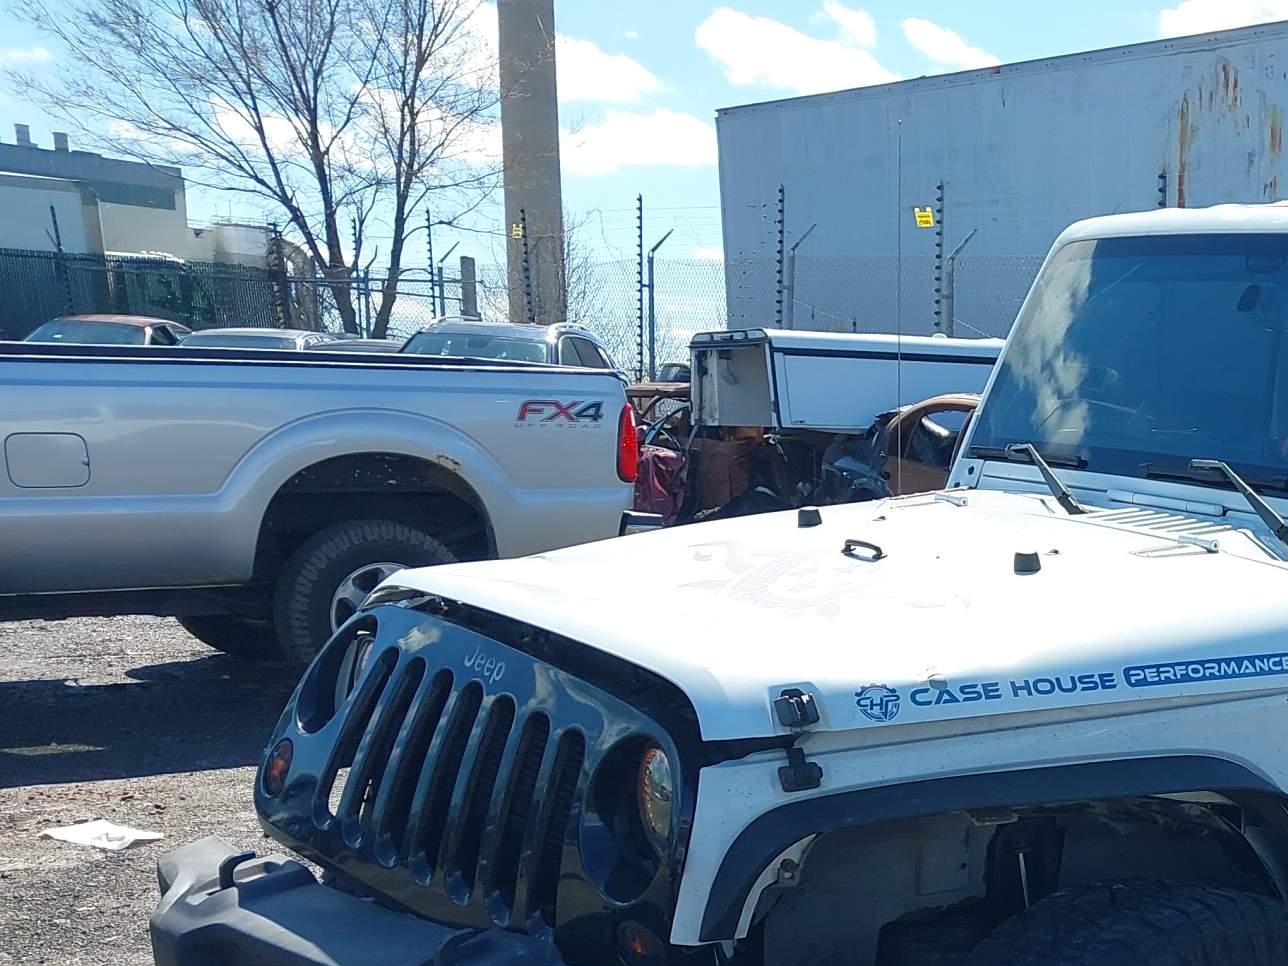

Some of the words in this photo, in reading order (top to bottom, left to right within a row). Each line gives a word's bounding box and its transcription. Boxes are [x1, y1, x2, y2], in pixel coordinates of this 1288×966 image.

[516, 400, 605, 422] FX4
[464, 646, 506, 684] Jeep
[910, 682, 1002, 706] CASE
[1011, 672, 1118, 698] HOUSE
